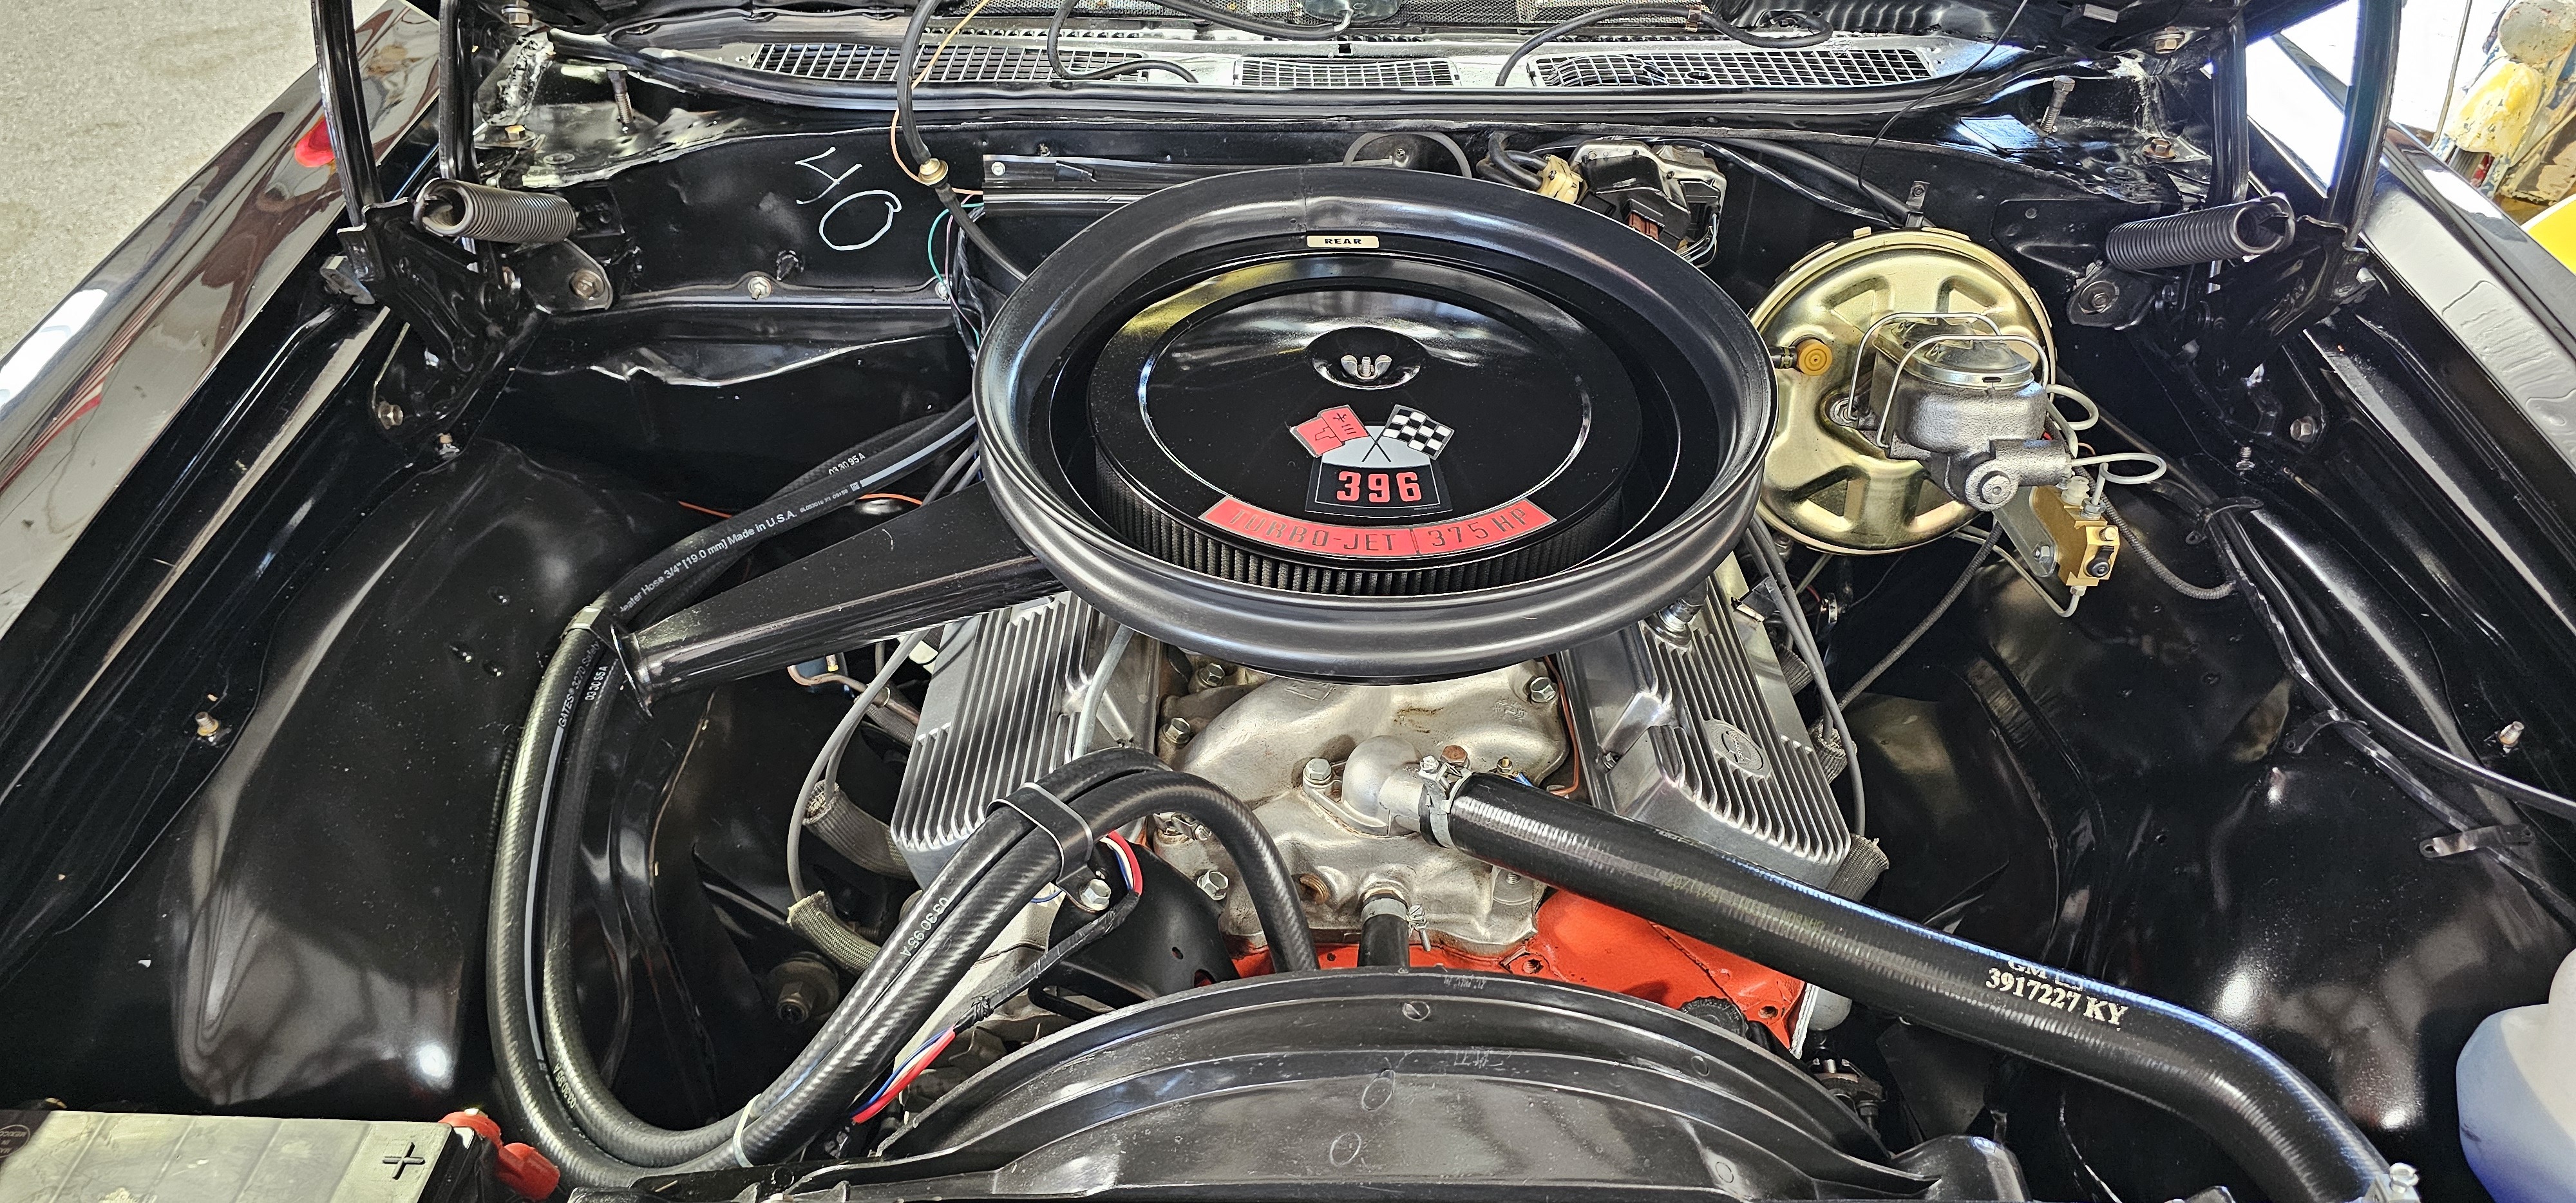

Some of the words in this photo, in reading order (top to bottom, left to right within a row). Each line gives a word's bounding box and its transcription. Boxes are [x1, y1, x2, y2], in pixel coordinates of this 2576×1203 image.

[795, 146, 902, 251] 40
[1336, 471, 1422, 503] 396
[641, 576, 665, 595] Hose
[707, 538, 728, 555] mm]
[727, 528, 755, 545] Made
[755, 523, 766, 532] in
[766, 510, 797, 527] U.S.A.
[1229, 509, 1396, 551] TURBO-JET
[1428, 522, 1489, 547] 375
[1491, 507, 1527, 533] HP
[572, 665, 586, 690] 3270
[1985, 967, 2082, 1012] 3917227
[2083, 996, 2128, 1025] KY
